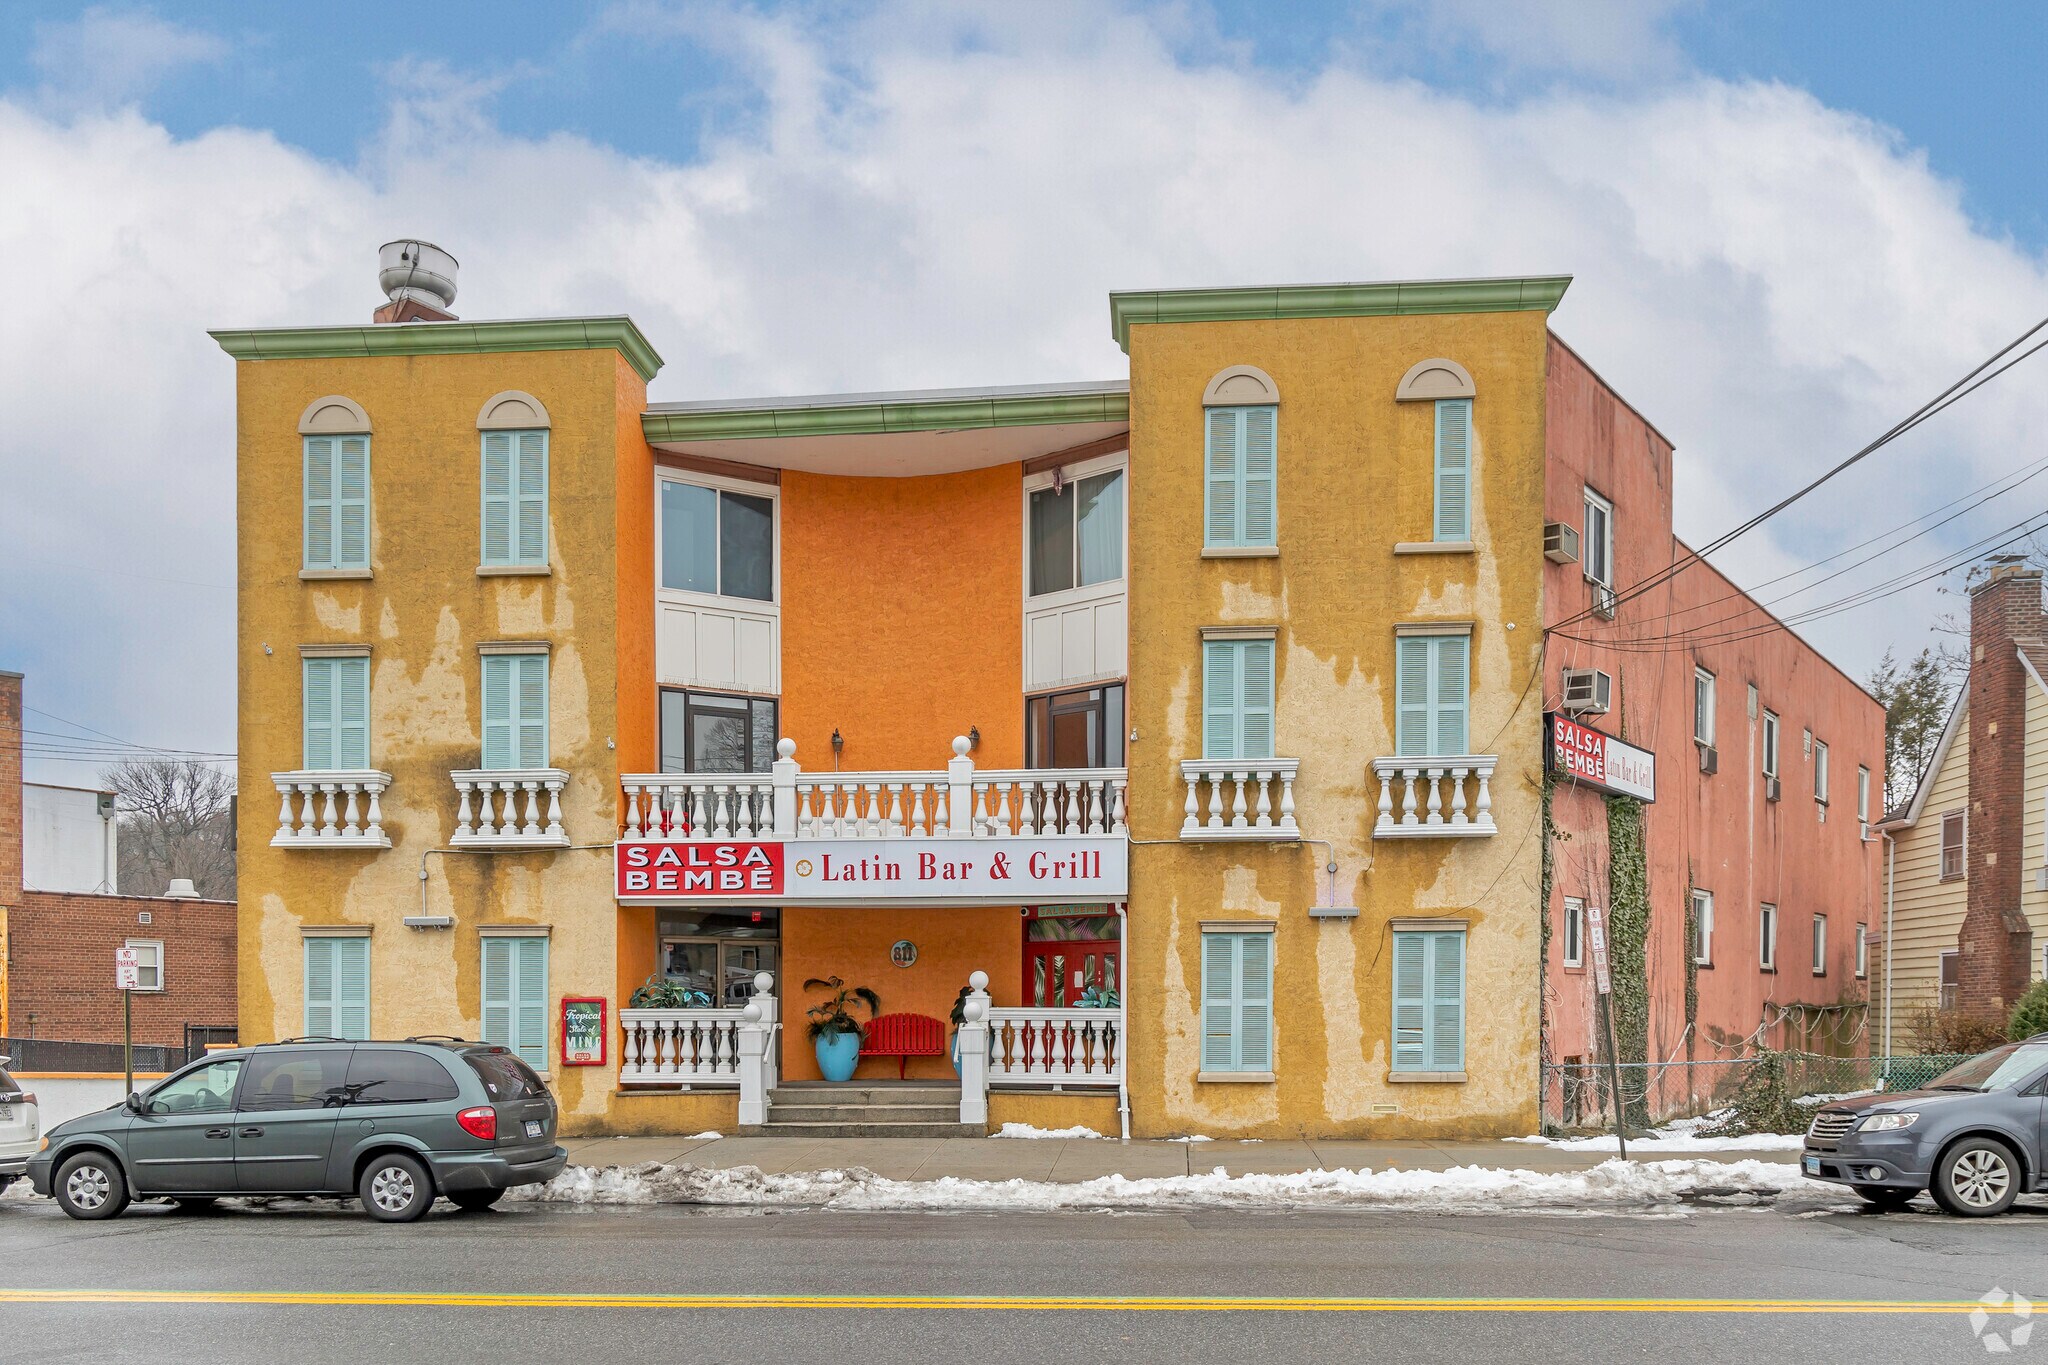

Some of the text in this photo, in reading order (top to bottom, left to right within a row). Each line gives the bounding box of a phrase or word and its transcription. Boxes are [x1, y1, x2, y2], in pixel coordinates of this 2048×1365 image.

[1556, 721, 1602, 757] SALSA
[1607, 750, 1651, 788] Latin Bar & Grill
[626, 846, 772, 867] SALSA
[821, 851, 1101, 881] Latin Bar & Grill
[625, 866, 773, 890] BEMBÉ
[1040, 906, 1071, 915] SALSA
[122, 950, 132, 959] NO
[893, 946, 914, 961] 811
[566, 1009, 602, 1023] Tropical
[569, 1024, 596, 1035] State of
